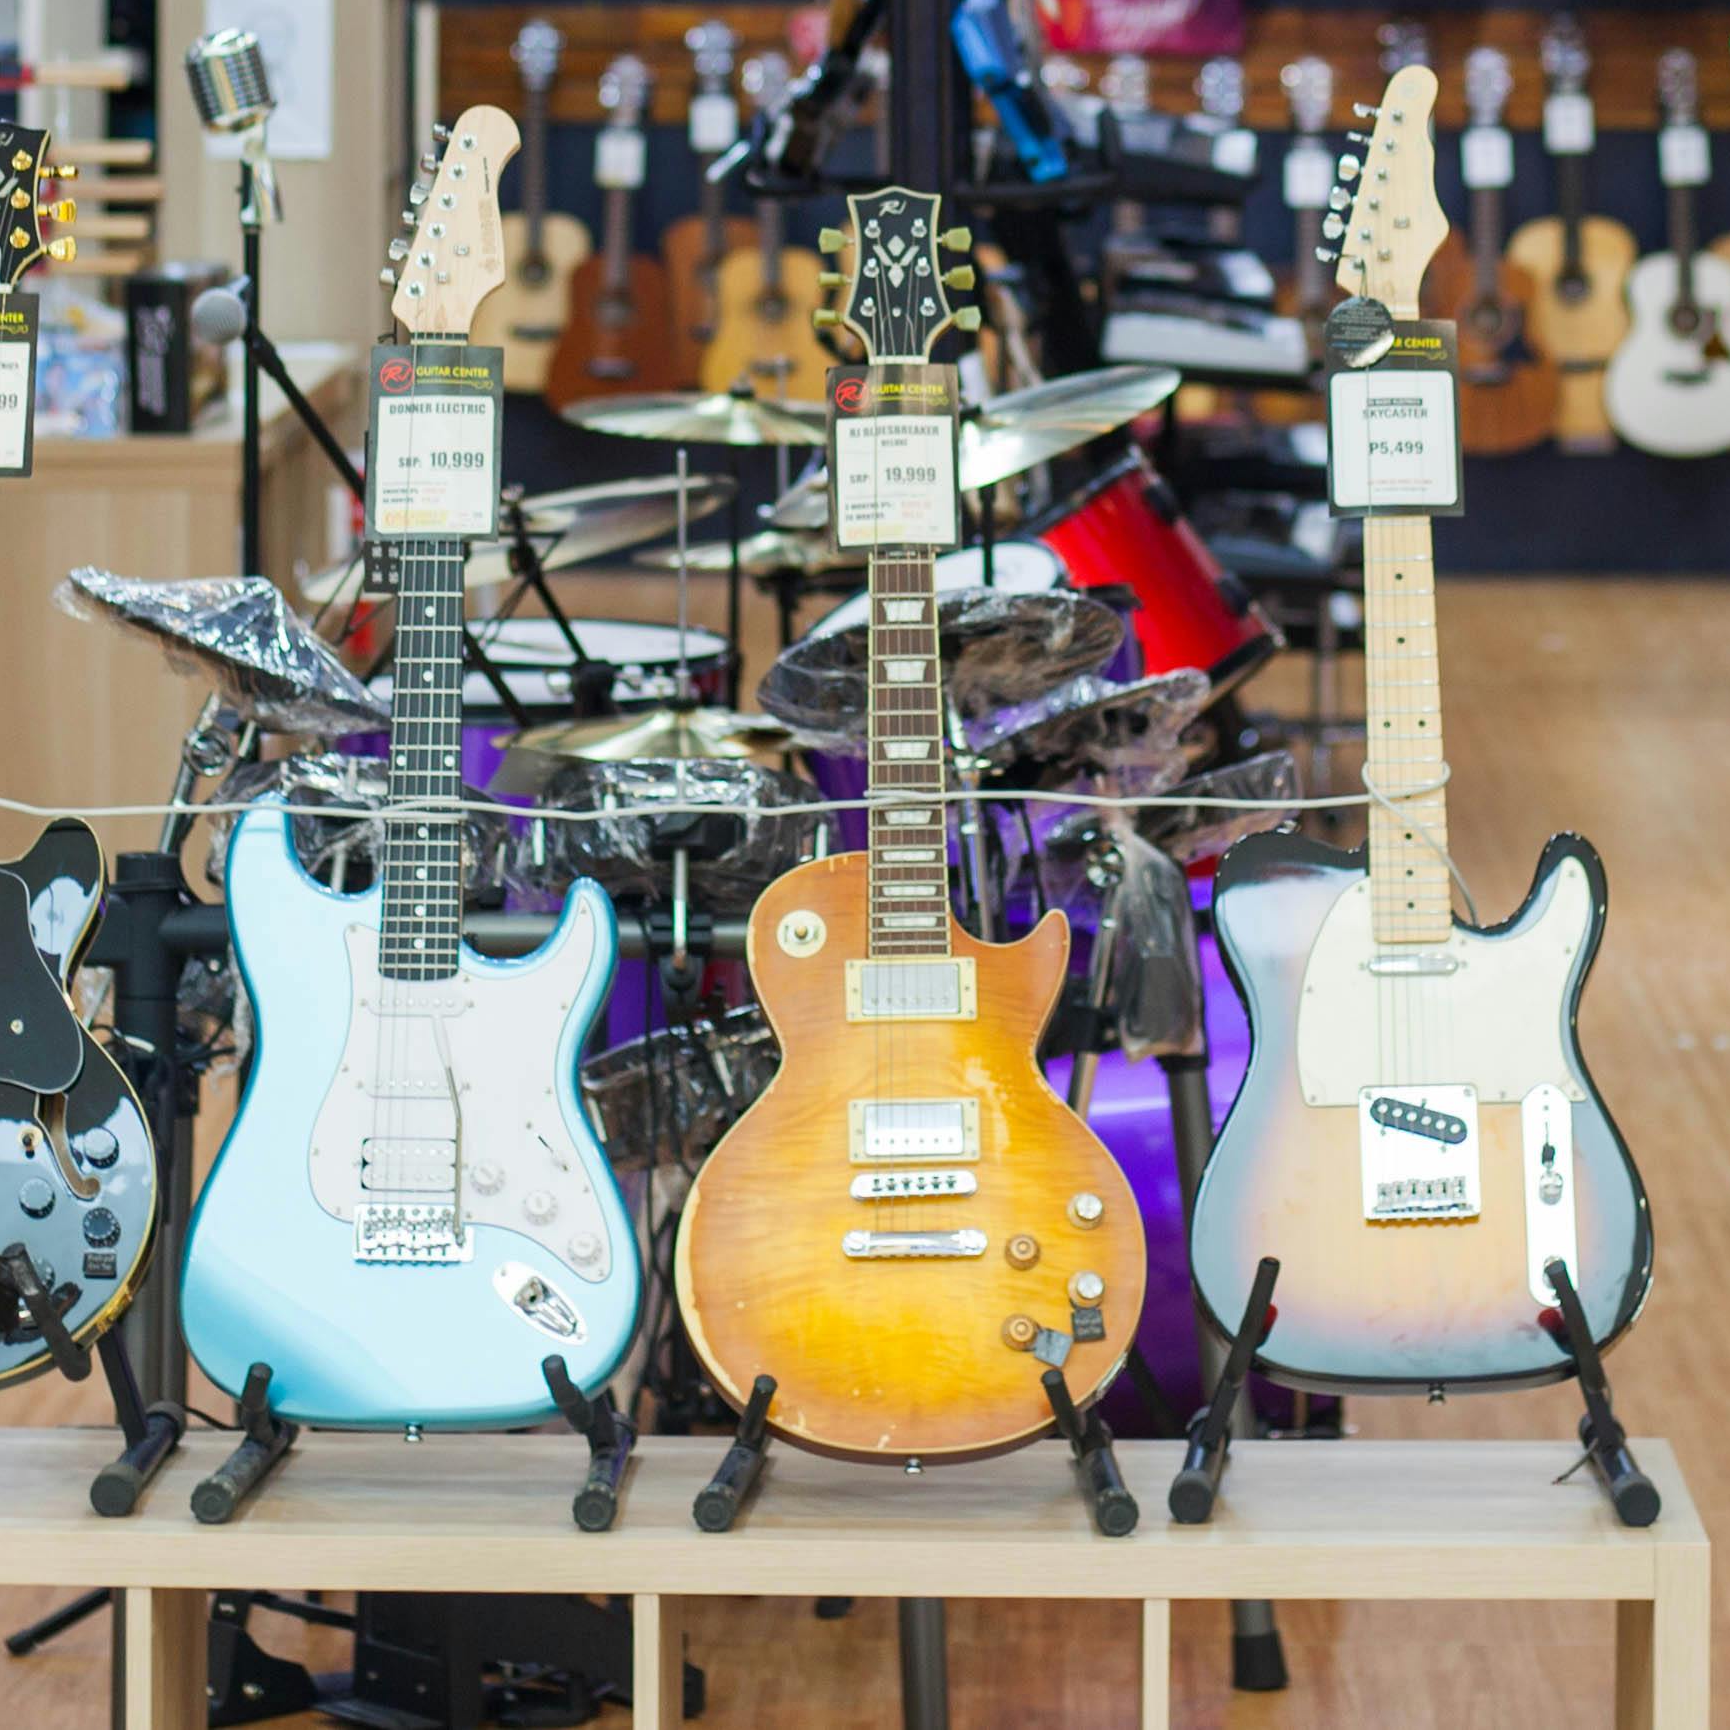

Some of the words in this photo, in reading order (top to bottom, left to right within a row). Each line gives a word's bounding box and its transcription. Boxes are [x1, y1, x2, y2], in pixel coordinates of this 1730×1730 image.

[1405, 337, 1442, 349] CENTER
[416, 366, 450, 377] GUITAR
[452, 367, 489, 378] CENTER
[871, 383, 905, 395] GUITAR
[907, 383, 944, 395] CENTER
[389, 403, 433, 415] DONNER
[435, 402, 487, 414] ELECTRIC
[1362, 408, 1428, 419] SKYCASTER
[430, 452, 485, 470] 10,999
[884, 467, 937, 484] 19,999
